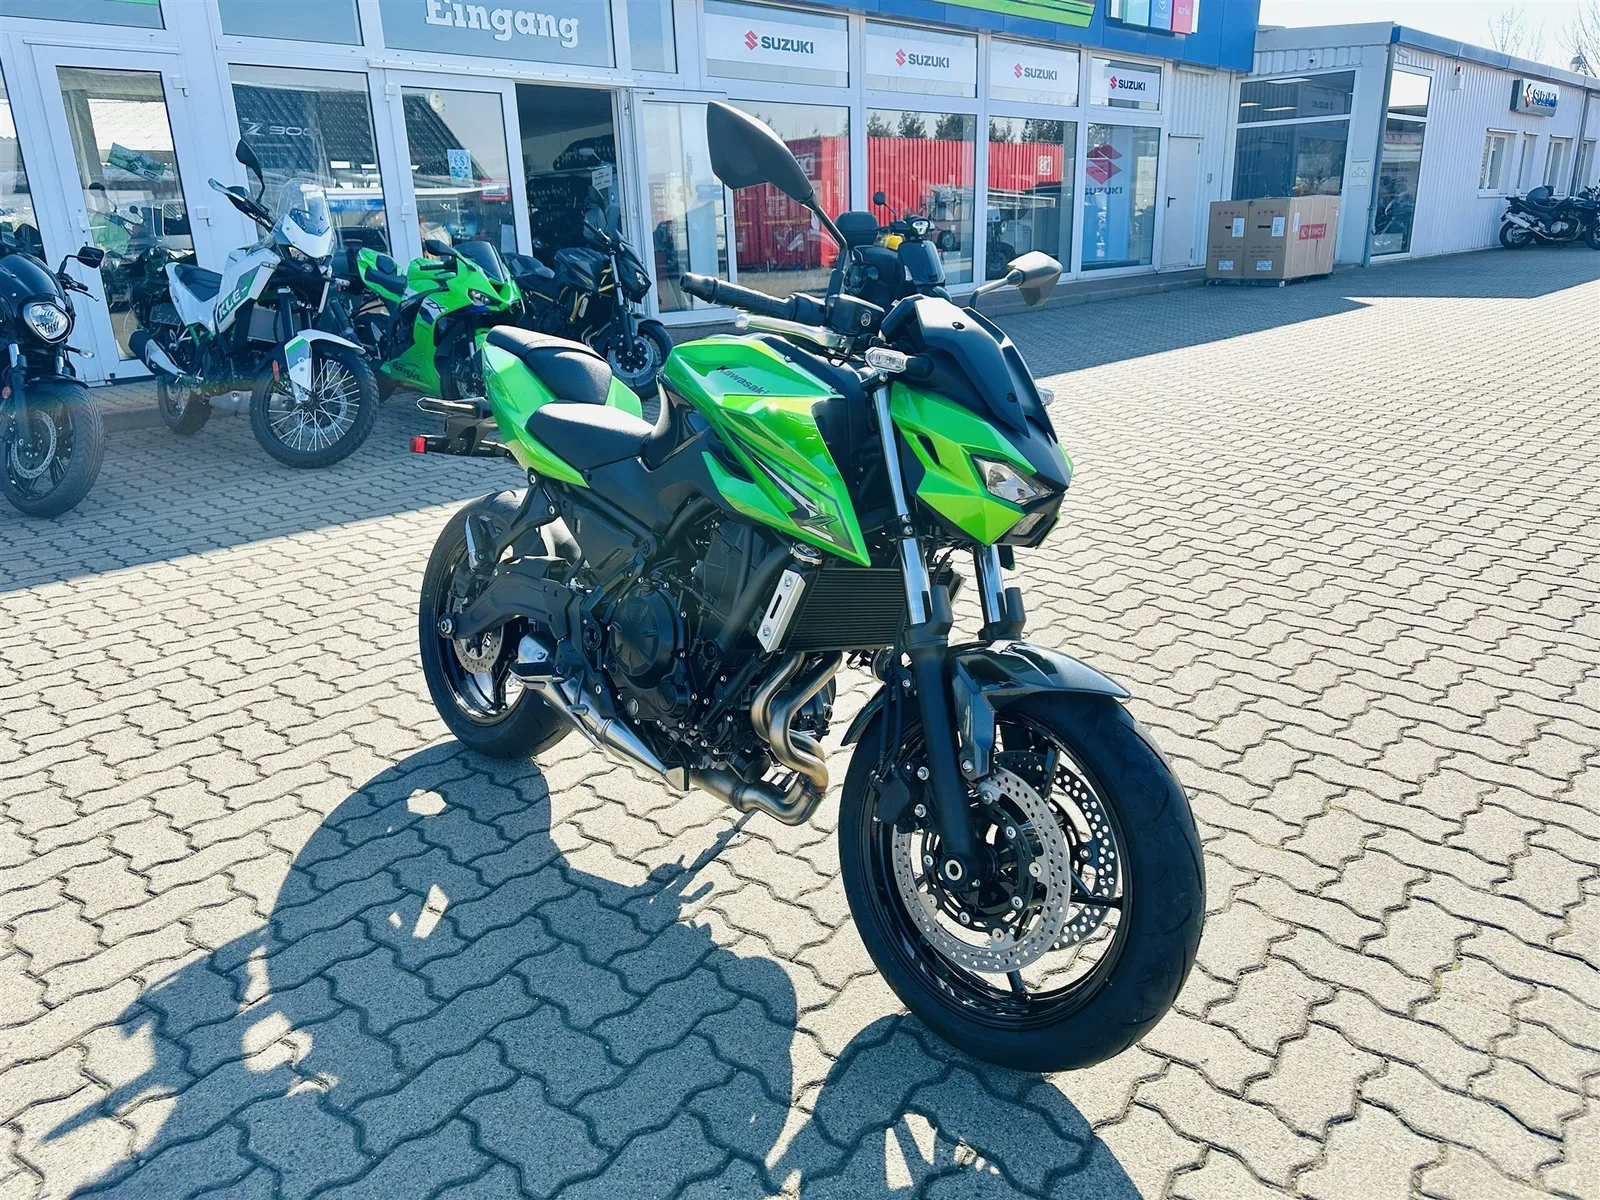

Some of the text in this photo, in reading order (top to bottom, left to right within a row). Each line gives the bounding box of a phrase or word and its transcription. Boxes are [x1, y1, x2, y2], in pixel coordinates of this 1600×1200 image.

[425, 0, 579, 48] Eingang
[760, 35, 814, 54] SUZUKI
[907, 53, 950, 68] SUZUKI
[1024, 67, 1058, 81] SUZUKI
[1118, 79, 1146, 91] SUZUKI
[1084, 186, 1123, 196] SUZUKI
[716, 365, 771, 395] Kawasaki
